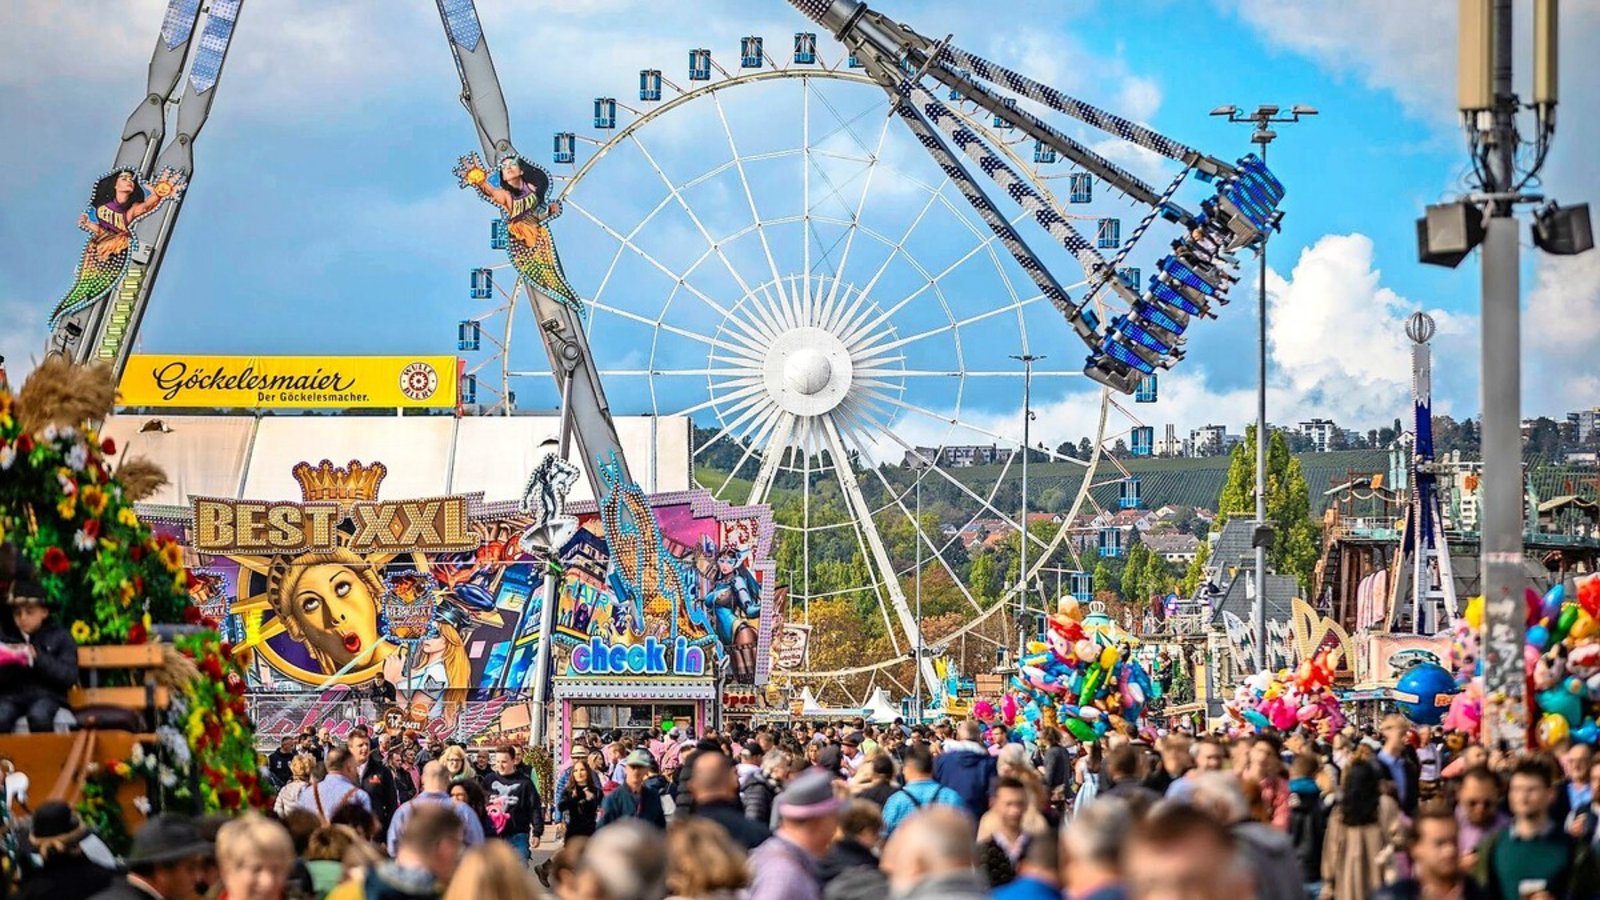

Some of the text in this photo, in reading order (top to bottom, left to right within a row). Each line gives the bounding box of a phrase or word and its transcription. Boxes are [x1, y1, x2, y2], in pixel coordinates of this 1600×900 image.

[152, 361, 356, 401] Göckelesmaier
[258, 391, 370, 402] Der Göckelesmacher.
[310, 487, 366, 500] THE
[199, 501, 478, 547] BEST XXL
[572, 636, 705, 676] check in
[722, 692, 756, 708] êpes
